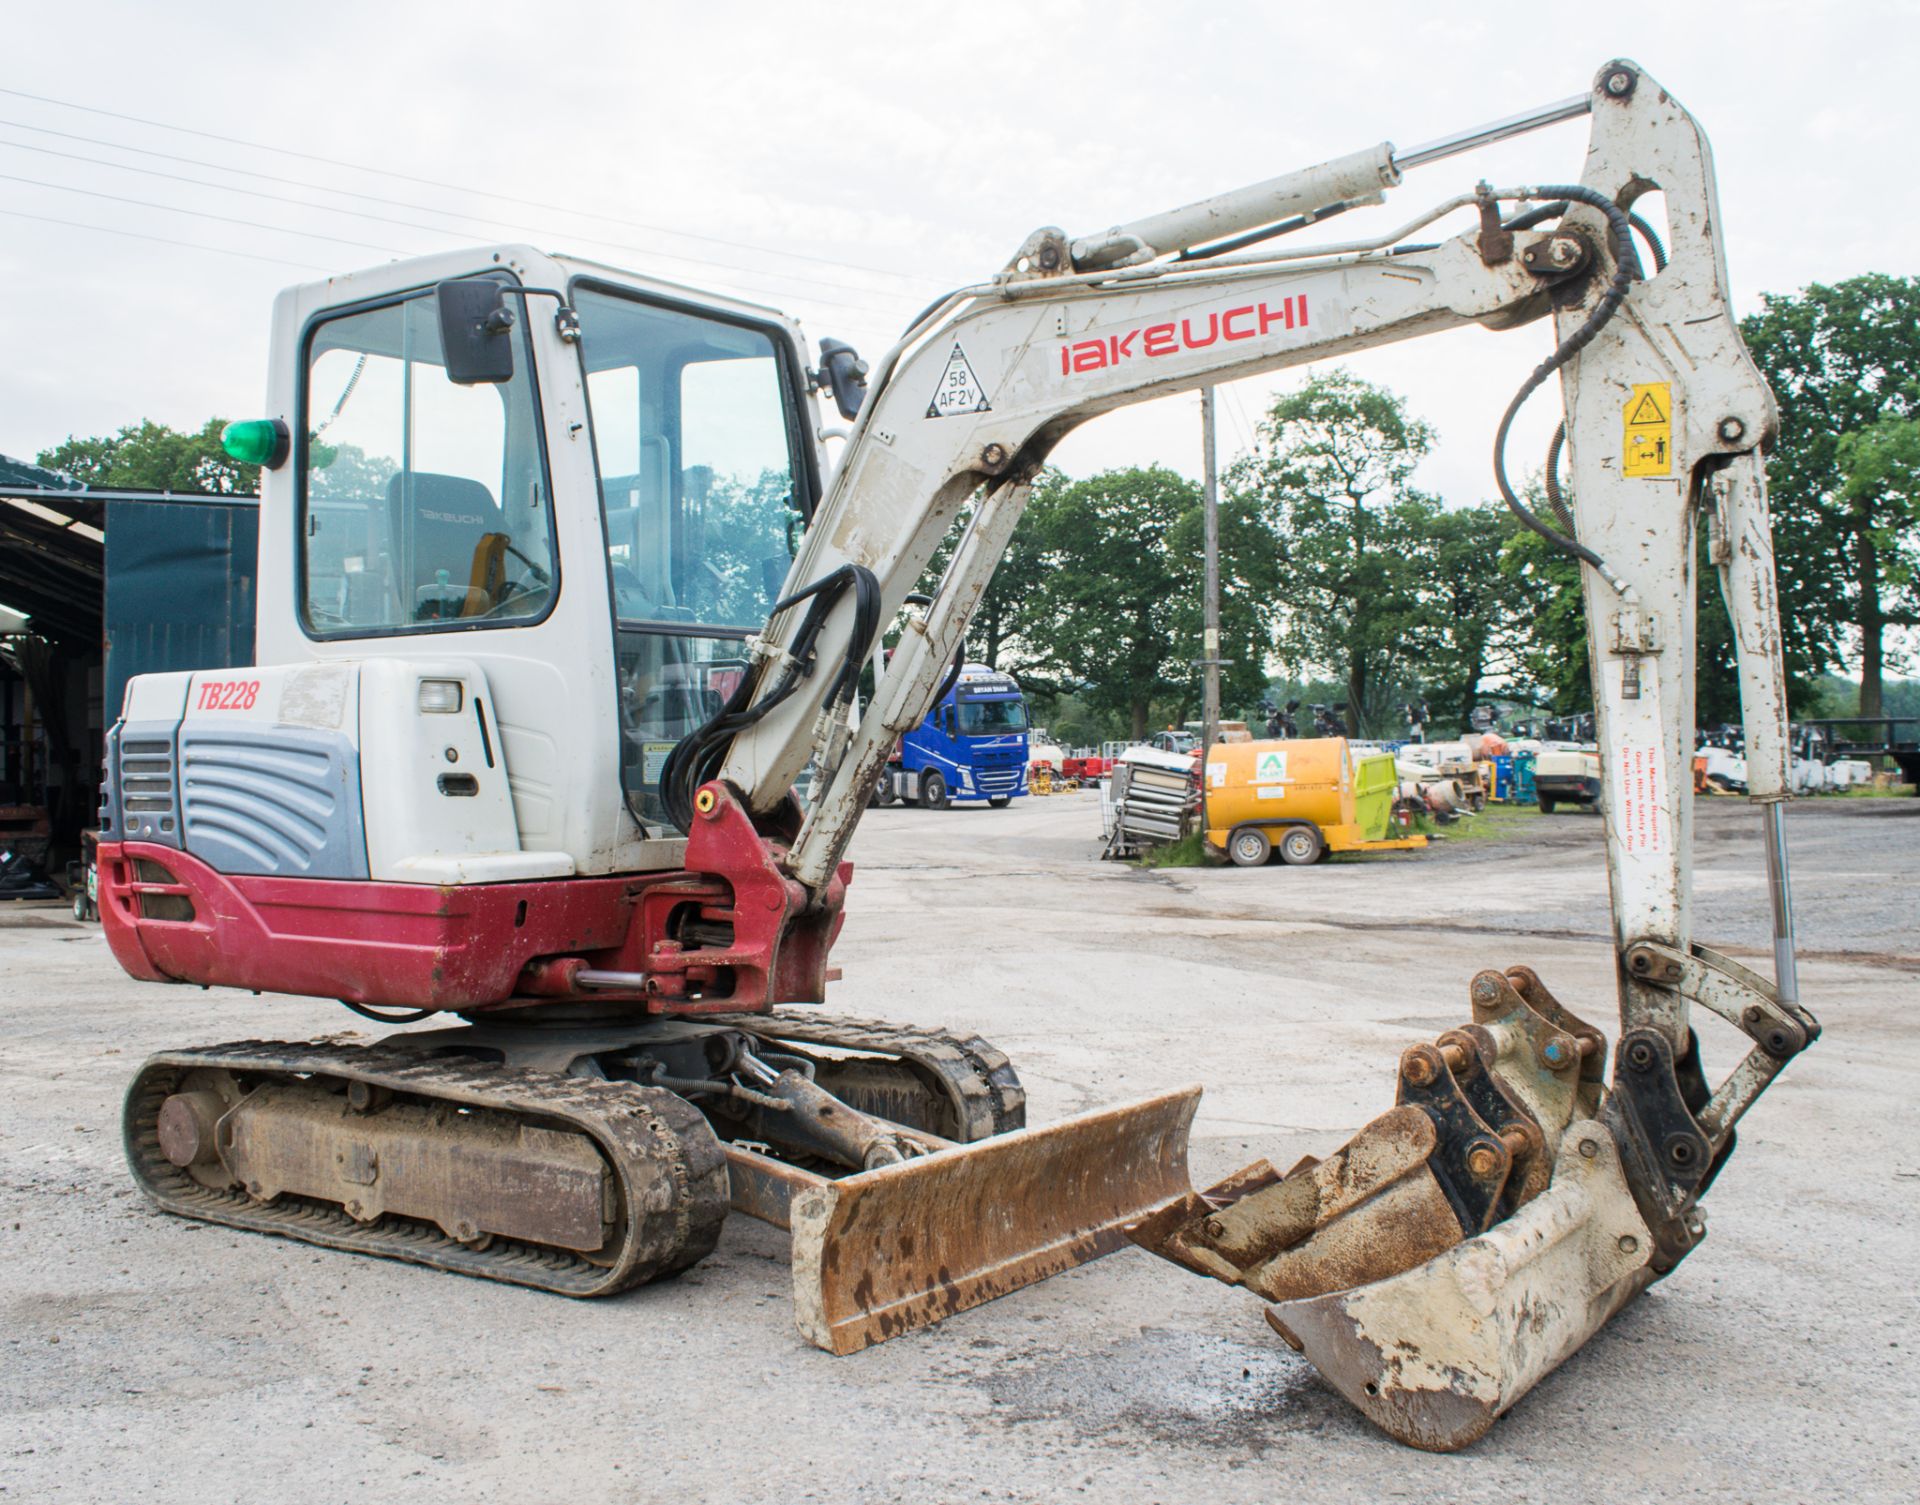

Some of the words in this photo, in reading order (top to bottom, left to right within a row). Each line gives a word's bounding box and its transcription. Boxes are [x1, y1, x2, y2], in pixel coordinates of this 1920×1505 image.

[949, 370, 967, 387] 58
[198, 681, 260, 710] TB228
[1622, 747, 1630, 759] Do
[1648, 747, 1656, 764] This
[1623, 761, 1631, 776] Not
[1649, 767, 1657, 801] Machine
[1625, 799, 1633, 832] Without
[1637, 804, 1645, 830] Safety
[1639, 833, 1647, 847] Pin
